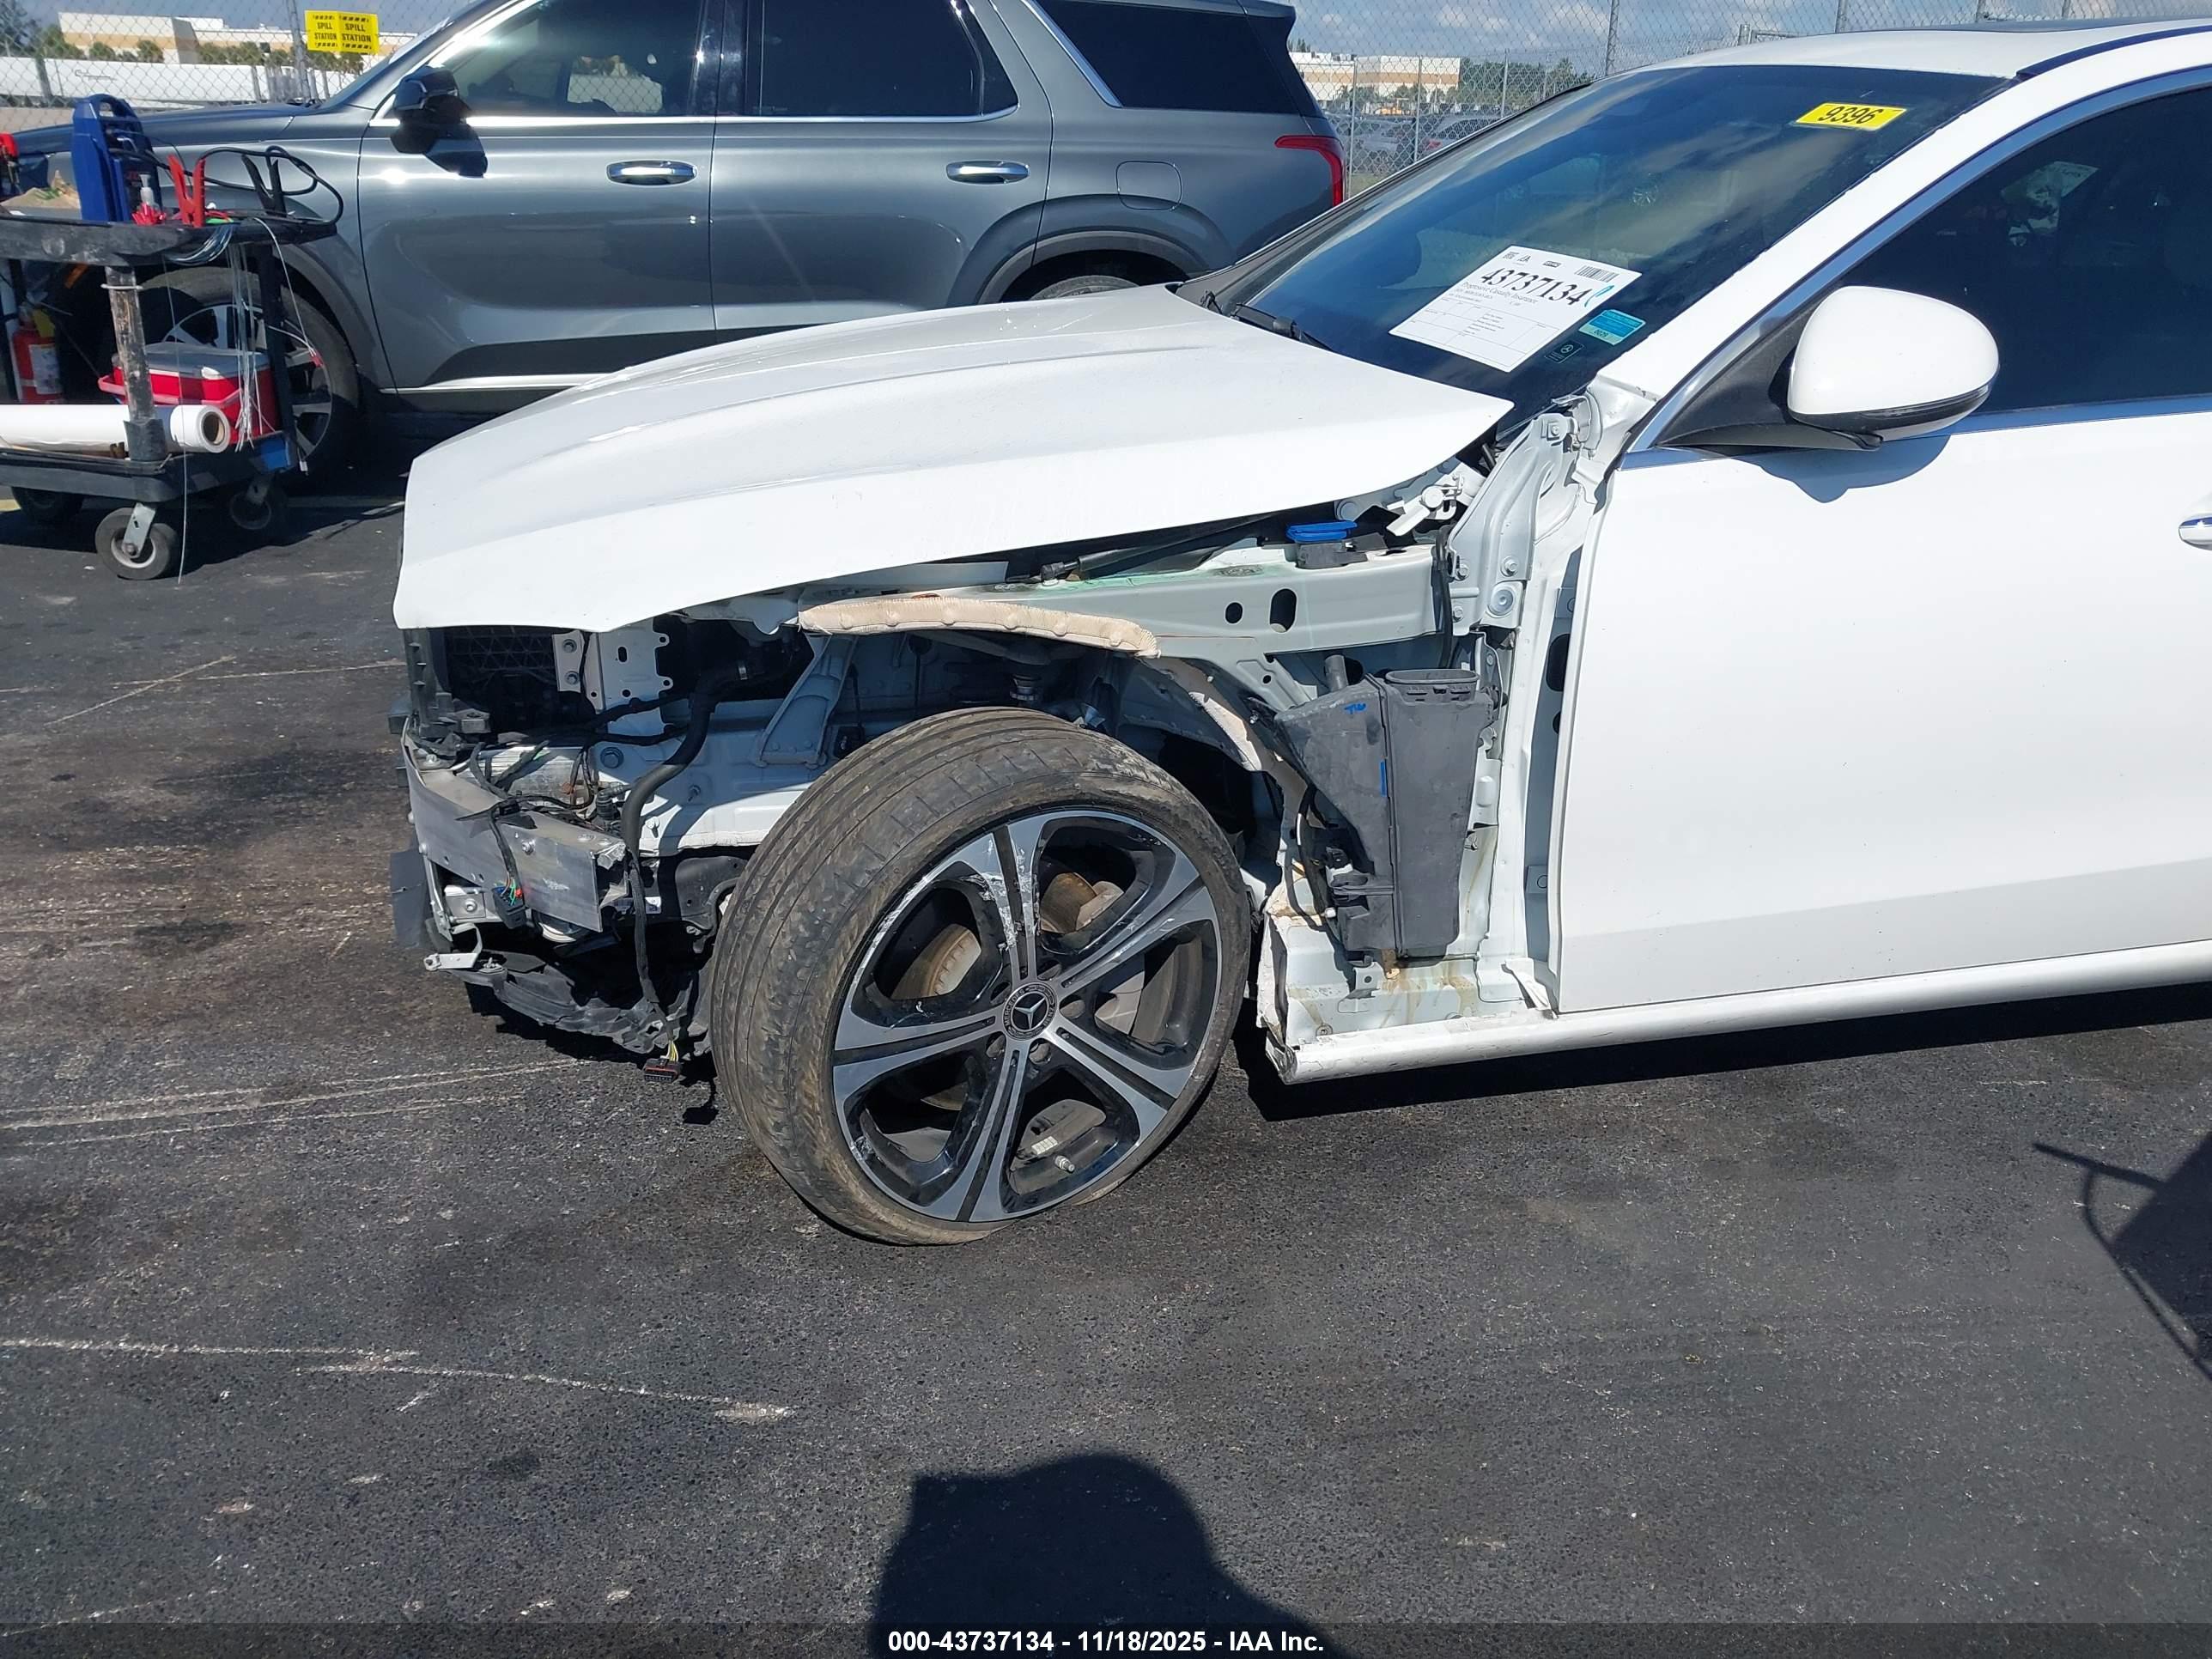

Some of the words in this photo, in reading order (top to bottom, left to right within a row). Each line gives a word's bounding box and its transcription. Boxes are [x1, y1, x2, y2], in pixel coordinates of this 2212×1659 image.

[344, 23, 366, 32] SPILL
[342, 33, 371, 42] STATION
[1818, 106, 1884, 125] 9396
[1480, 267, 1594, 306] 43737134
[1004, 988, 1025, 1026] MERCEDES
